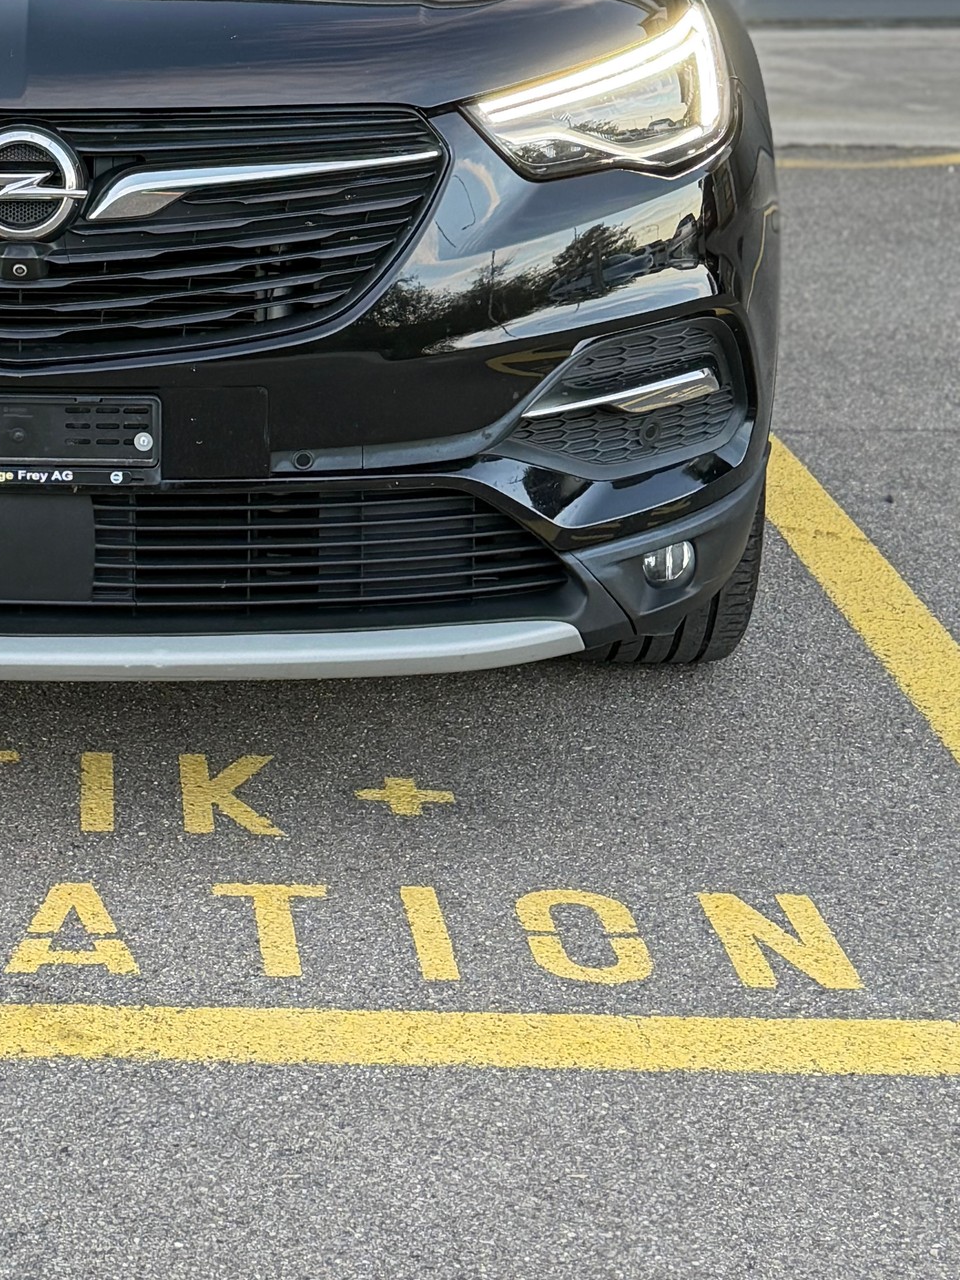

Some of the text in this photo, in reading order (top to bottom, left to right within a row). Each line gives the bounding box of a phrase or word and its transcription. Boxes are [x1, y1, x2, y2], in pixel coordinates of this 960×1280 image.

[17, 470, 49, 483] Frey
[51, 470, 74, 481] AG
[355, 776, 455, 816] +
